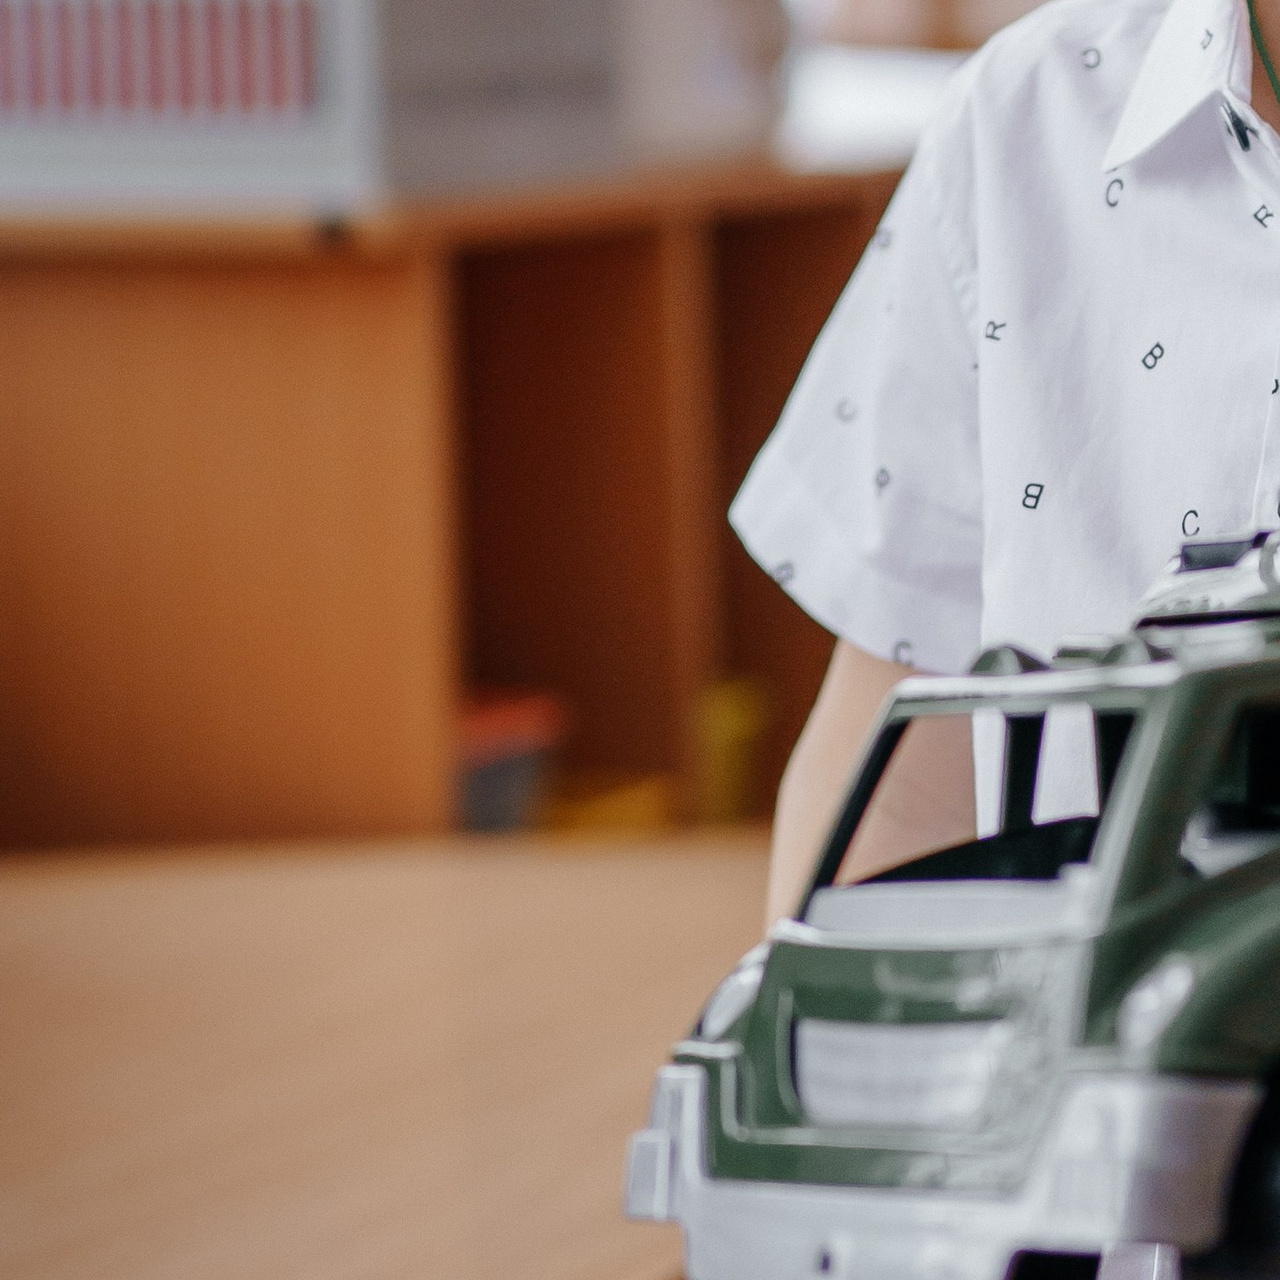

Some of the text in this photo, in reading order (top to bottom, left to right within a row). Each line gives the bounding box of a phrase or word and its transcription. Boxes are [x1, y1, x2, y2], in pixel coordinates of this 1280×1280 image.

[1105, 178, 1123, 208] C
[1141, 341, 1164, 369] B
[1021, 482, 1044, 509] B
[1181, 509, 1198, 536] C
